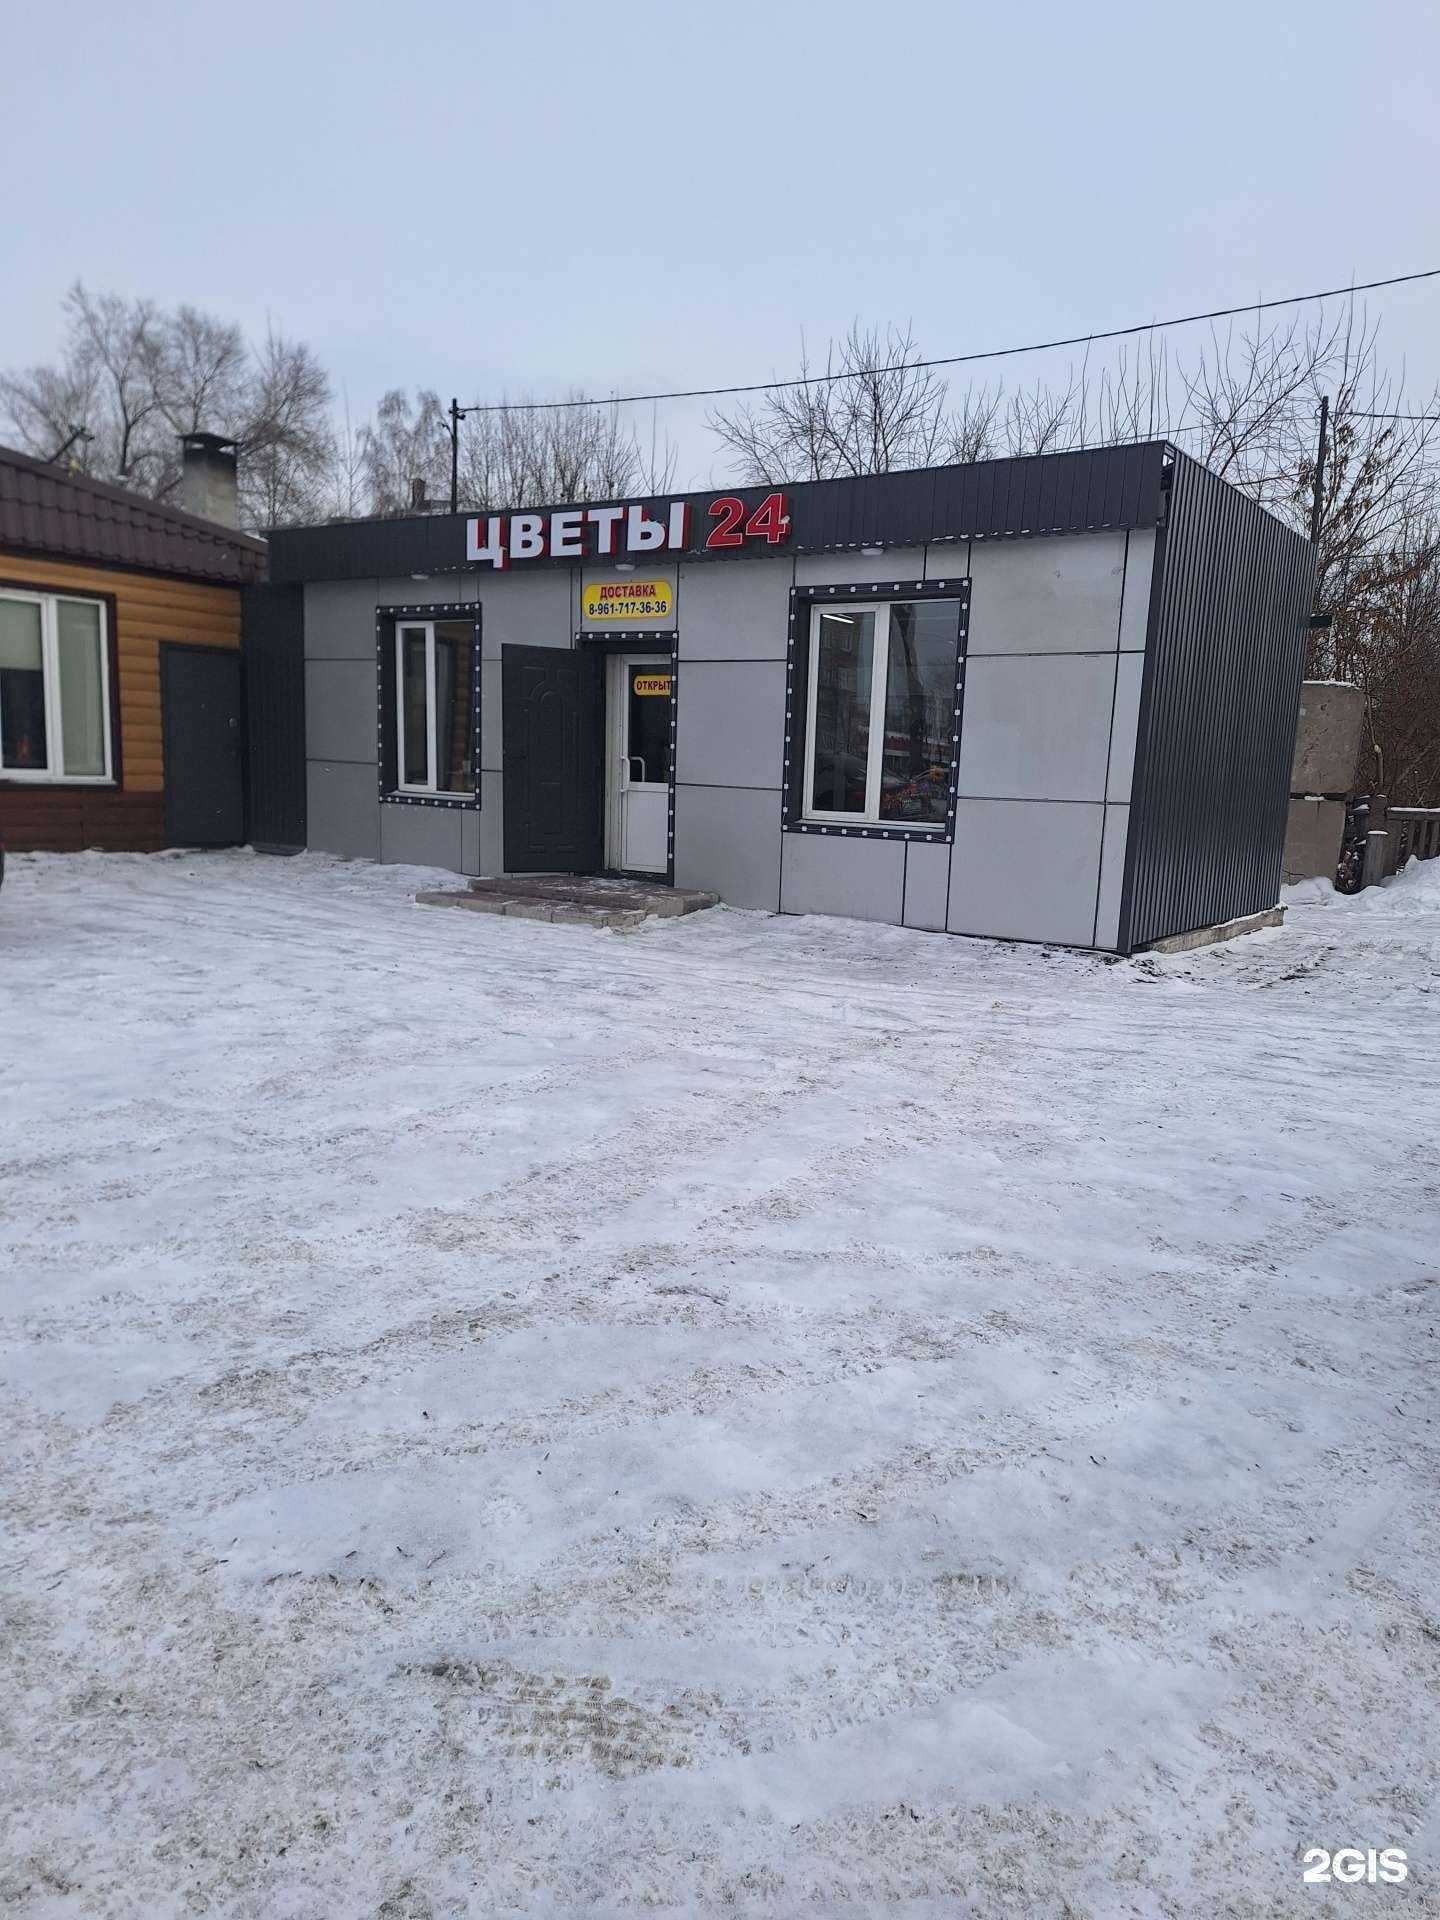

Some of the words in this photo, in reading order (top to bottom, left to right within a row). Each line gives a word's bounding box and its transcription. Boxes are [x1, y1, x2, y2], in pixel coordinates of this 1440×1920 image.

[466, 502, 690, 570] ЦВЕТЫ
[706, 493, 791, 548] 24
[600, 584, 656, 600] ДОСТАВКА
[588, 601, 667, 615] 8-961-717-36-36
